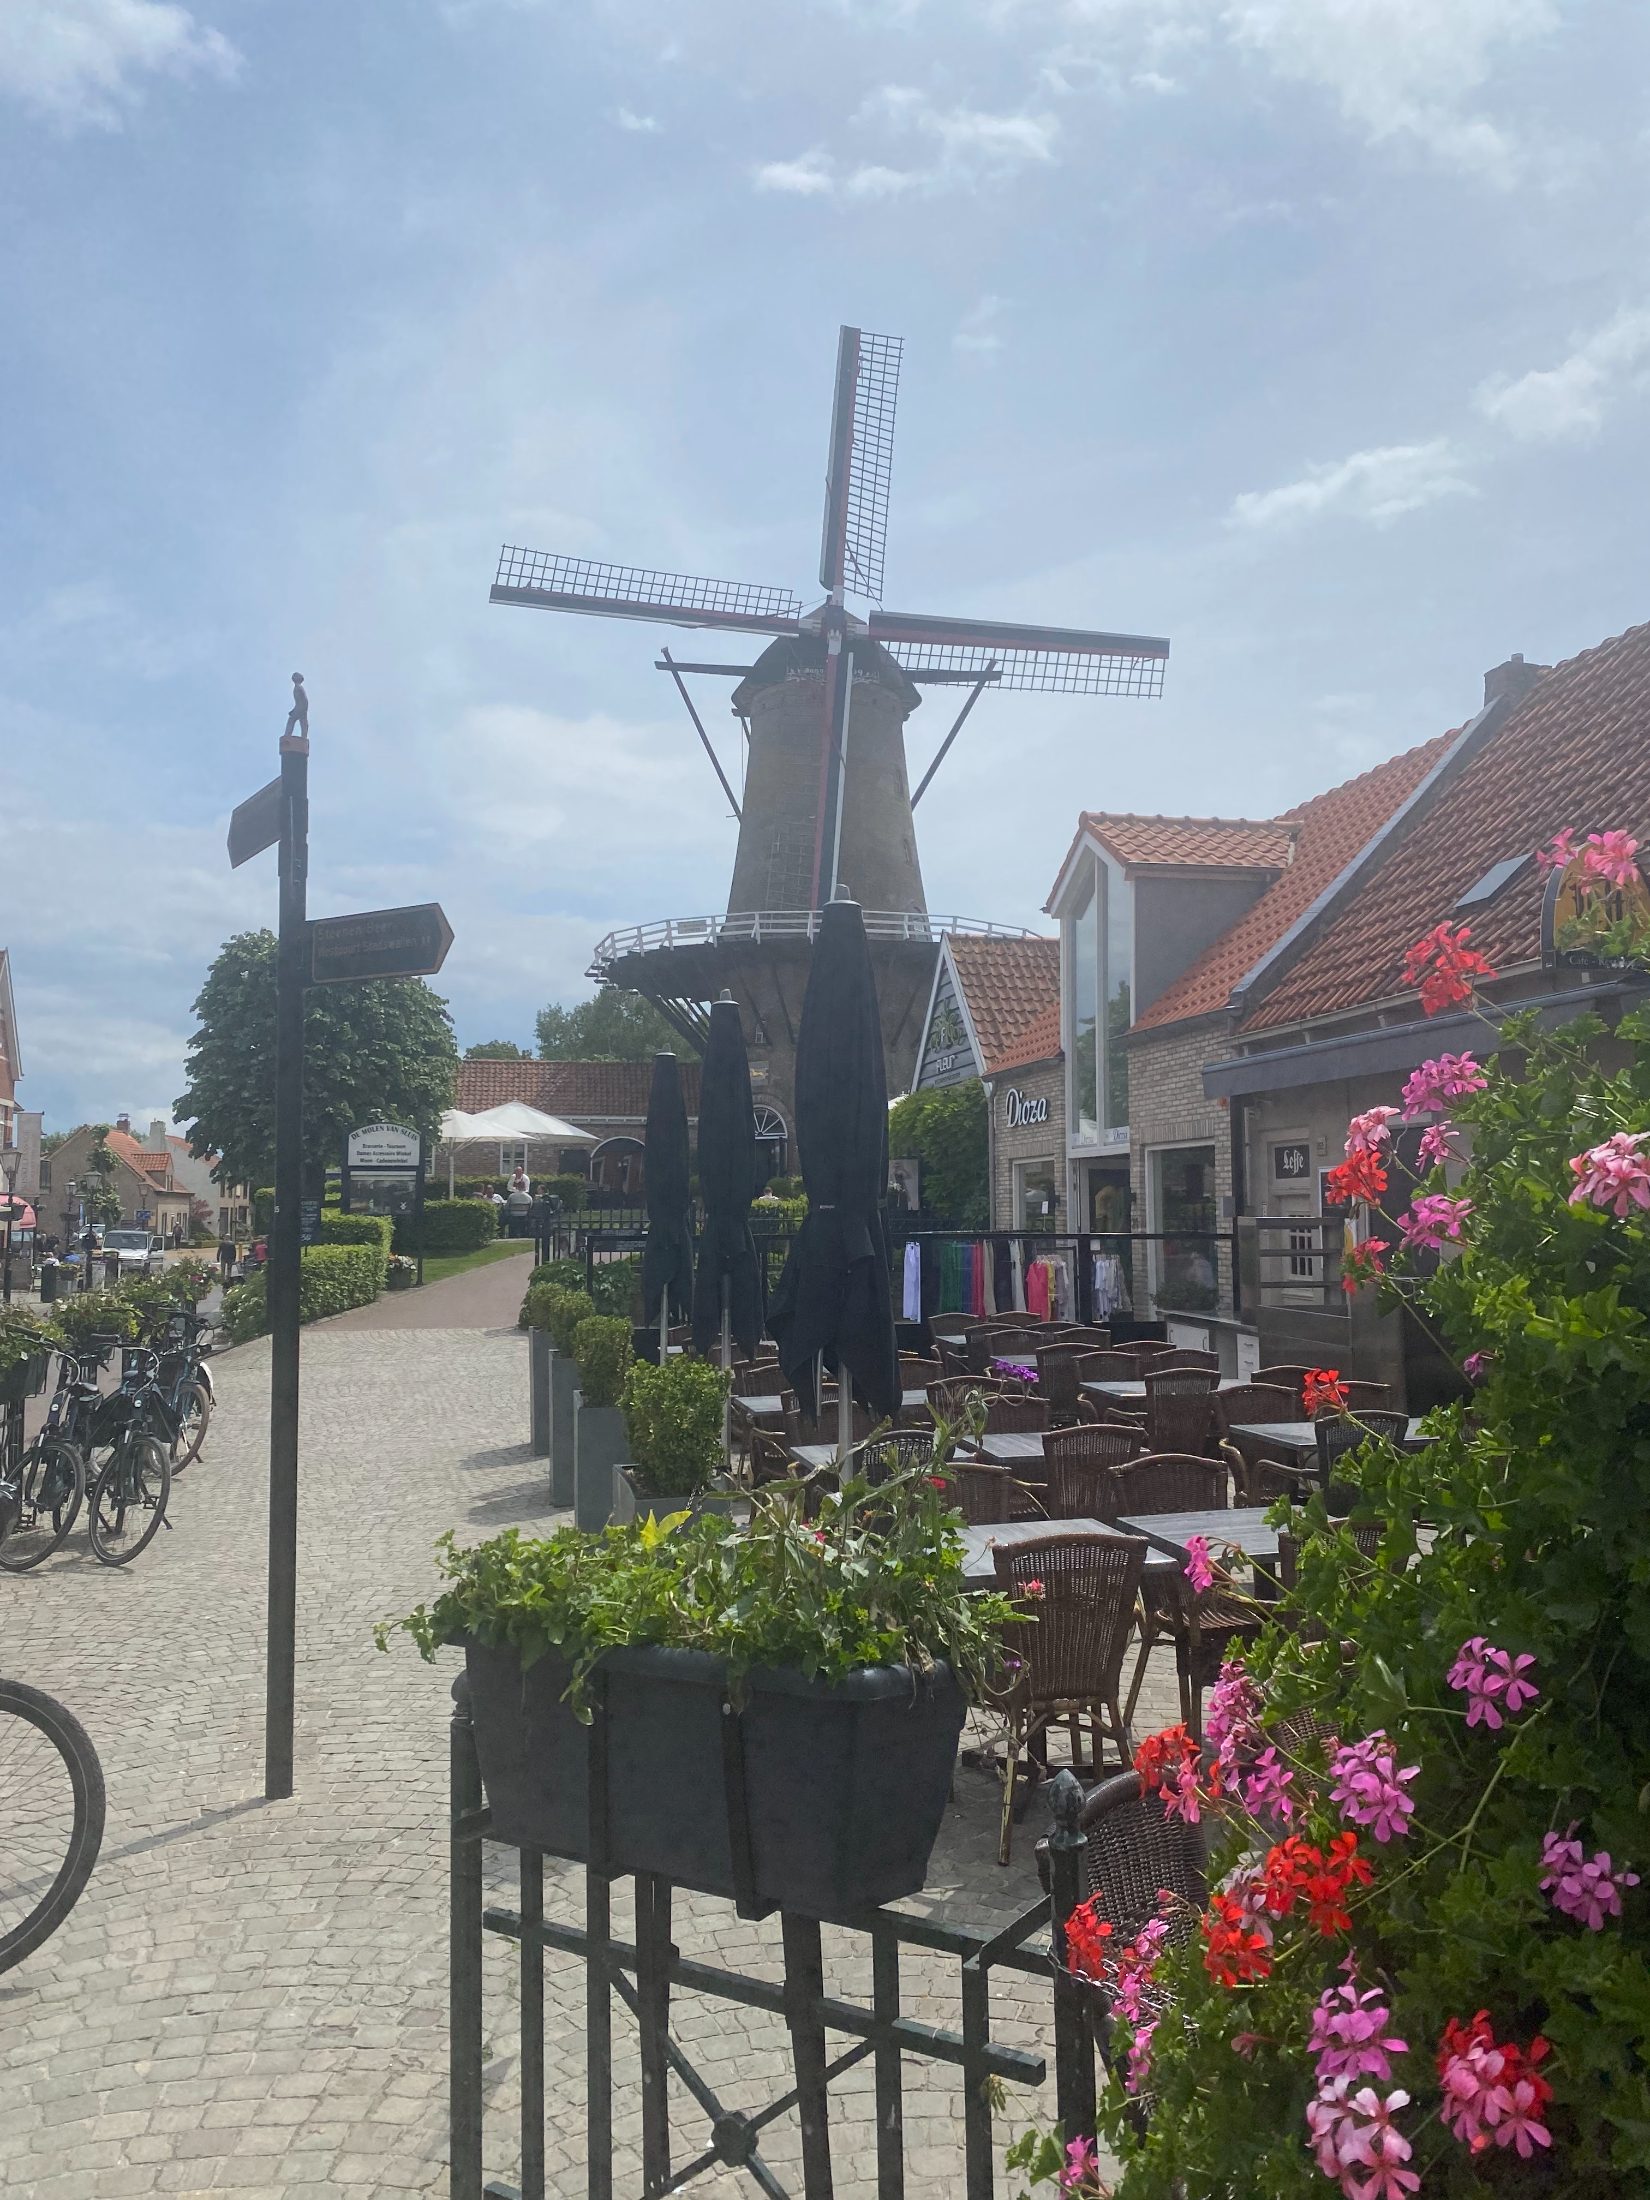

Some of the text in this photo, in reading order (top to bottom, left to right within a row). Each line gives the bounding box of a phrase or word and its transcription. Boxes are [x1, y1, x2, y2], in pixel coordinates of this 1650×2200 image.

[1006, 1088, 1048, 1128] Dioza
[361, 1125, 385, 1135] MOLEN
[386, 1125, 399, 1133] VAN
[401, 1128, 418, 1141] SLUIS
[1283, 1150, 1304, 1175] Leffe
